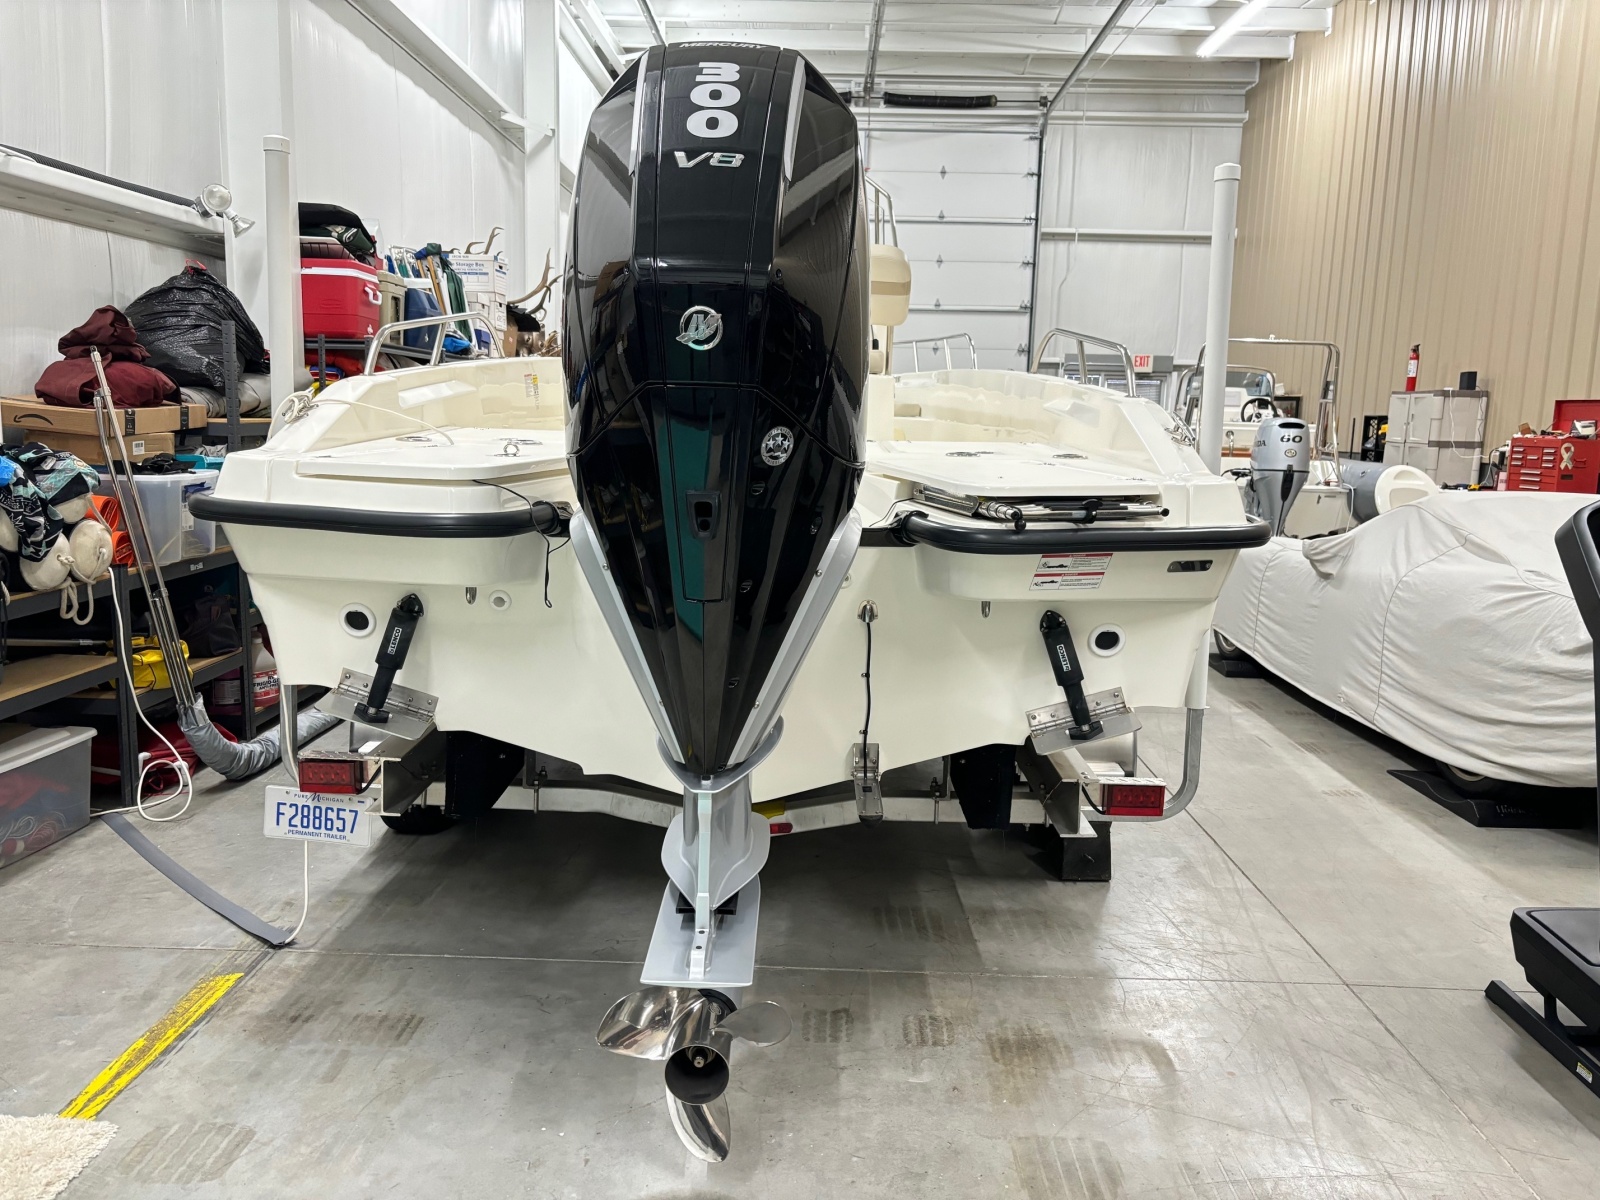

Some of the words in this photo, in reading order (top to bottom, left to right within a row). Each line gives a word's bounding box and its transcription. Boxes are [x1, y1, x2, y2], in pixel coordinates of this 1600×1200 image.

[686, 61, 741, 138] 300
[674, 151, 745, 168] V8
[1134, 355, 1151, 368] EXIT
[1280, 434, 1303, 443] 60
[391, 627, 401, 649] LENCO
[1058, 645, 1069, 666] LENCO
[305, 792, 344, 803] MICHIGAN
[276, 801, 359, 834] F288657
[287, 829, 323, 838] PERMANENT
[323, 832, 347, 841] TRAILER
